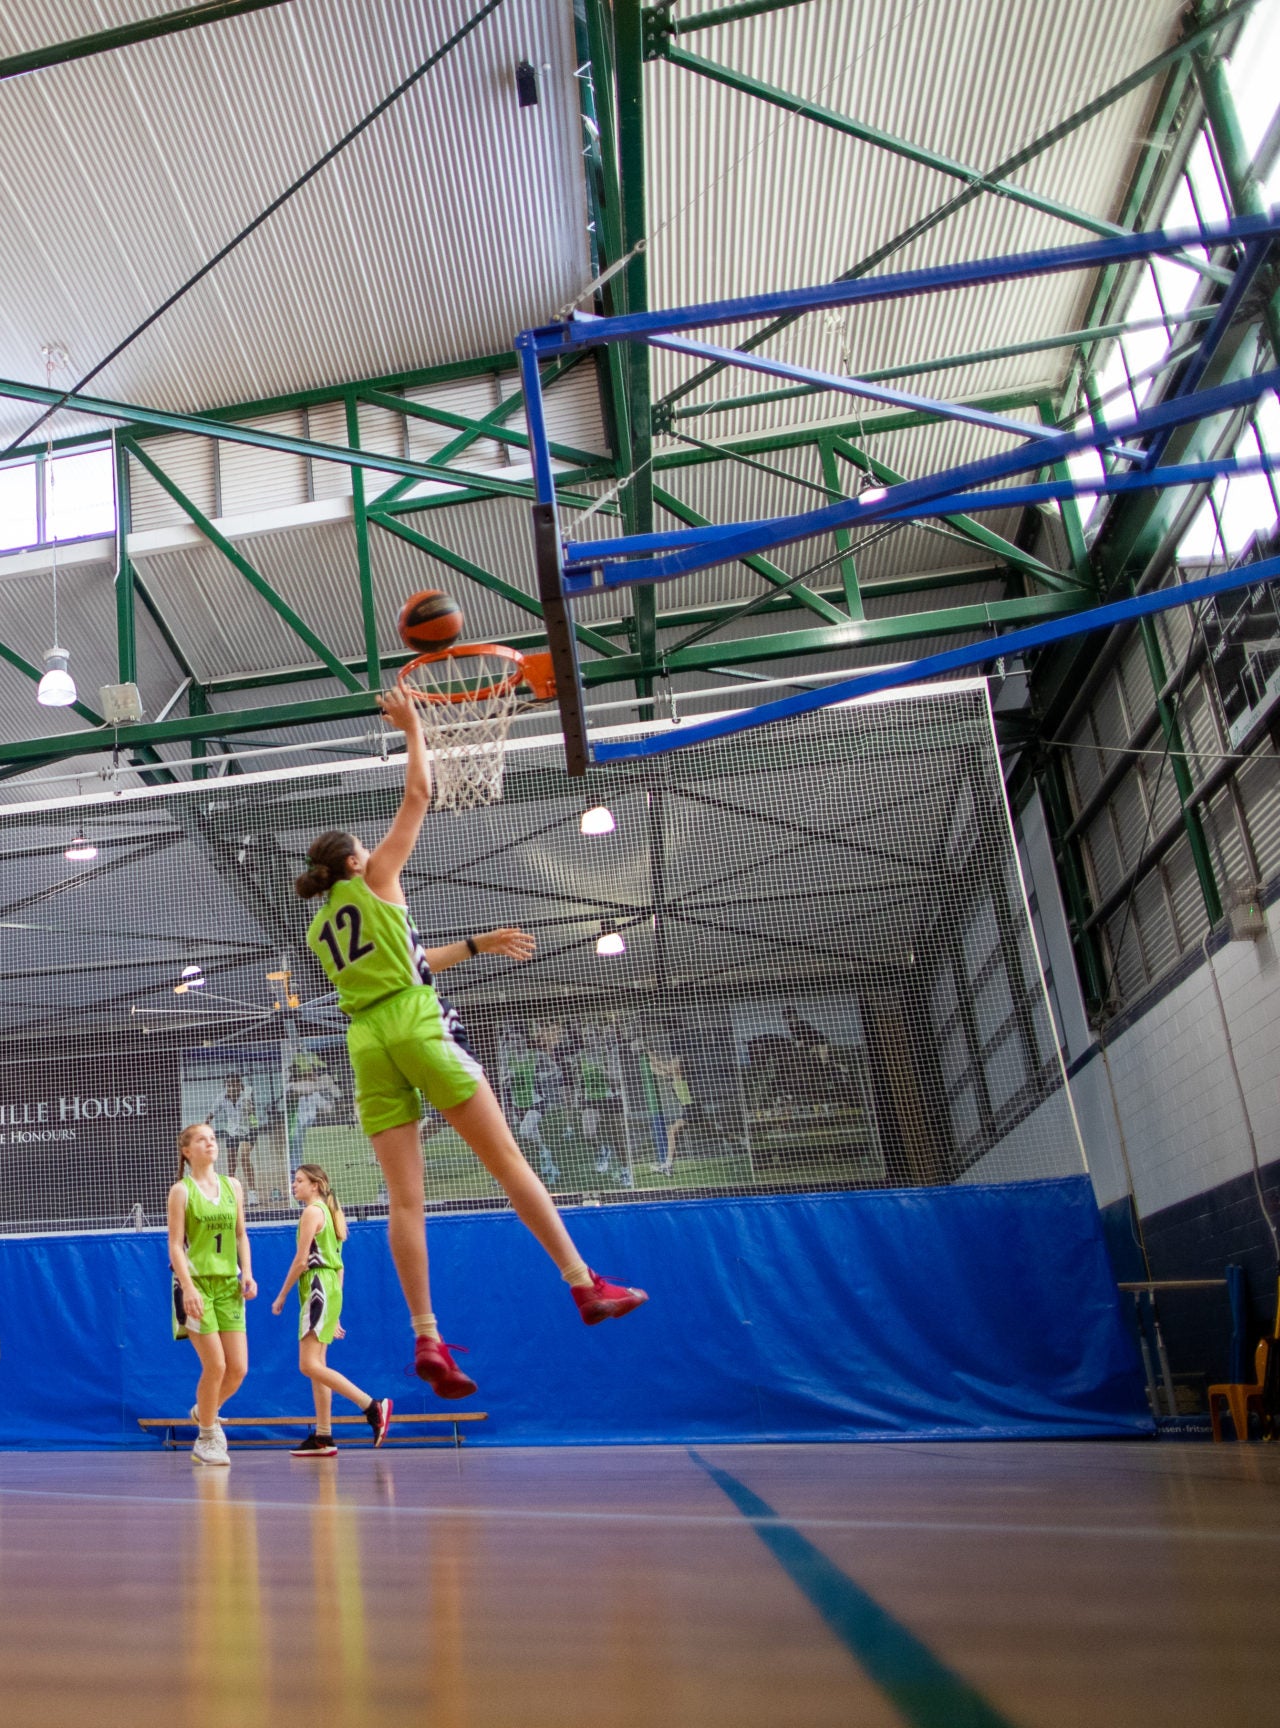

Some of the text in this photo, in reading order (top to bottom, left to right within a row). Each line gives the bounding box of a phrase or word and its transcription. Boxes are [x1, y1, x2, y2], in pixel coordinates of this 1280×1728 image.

[318, 904, 375, 972] 12
[59, 1095, 148, 1121] HOUSE
[11, 1129, 77, 1143] HONOURS
[207, 1223, 232, 1231] HOUSE
[214, 1233, 222, 1253] 1
